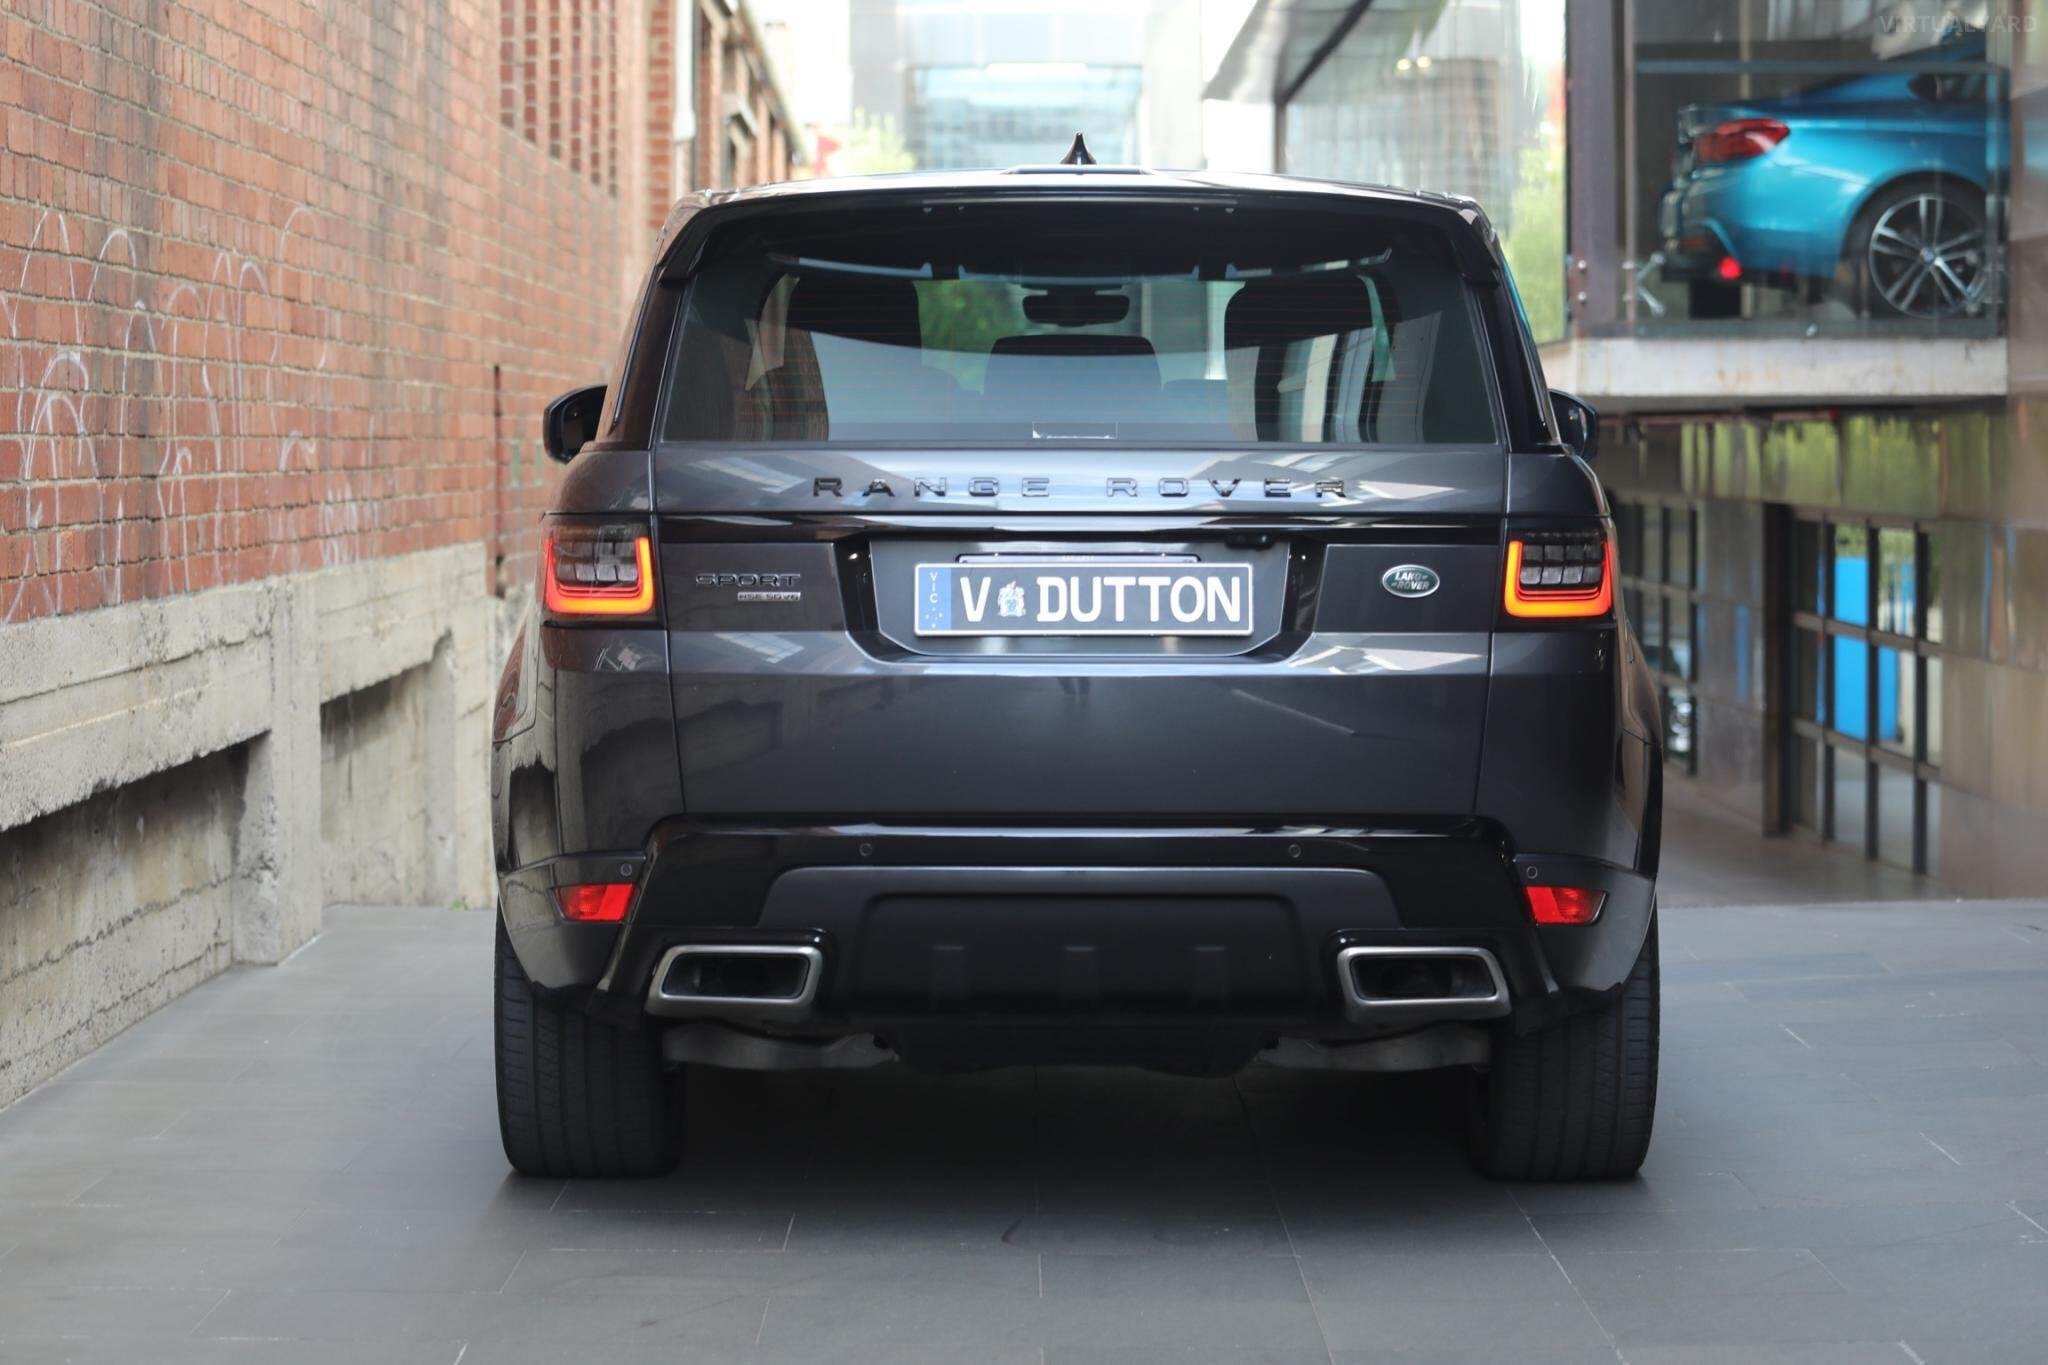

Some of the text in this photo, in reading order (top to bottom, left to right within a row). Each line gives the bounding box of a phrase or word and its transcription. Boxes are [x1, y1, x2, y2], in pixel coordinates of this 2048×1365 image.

[813, 477, 1347, 498] RANGE ROVER
[695, 573, 801, 587] SPORT
[1394, 571, 1422, 581] LAND
[927, 571, 939, 604] VIC
[1396, 580, 1430, 591] ROVER
[960, 576, 1241, 622] V DUTTON
